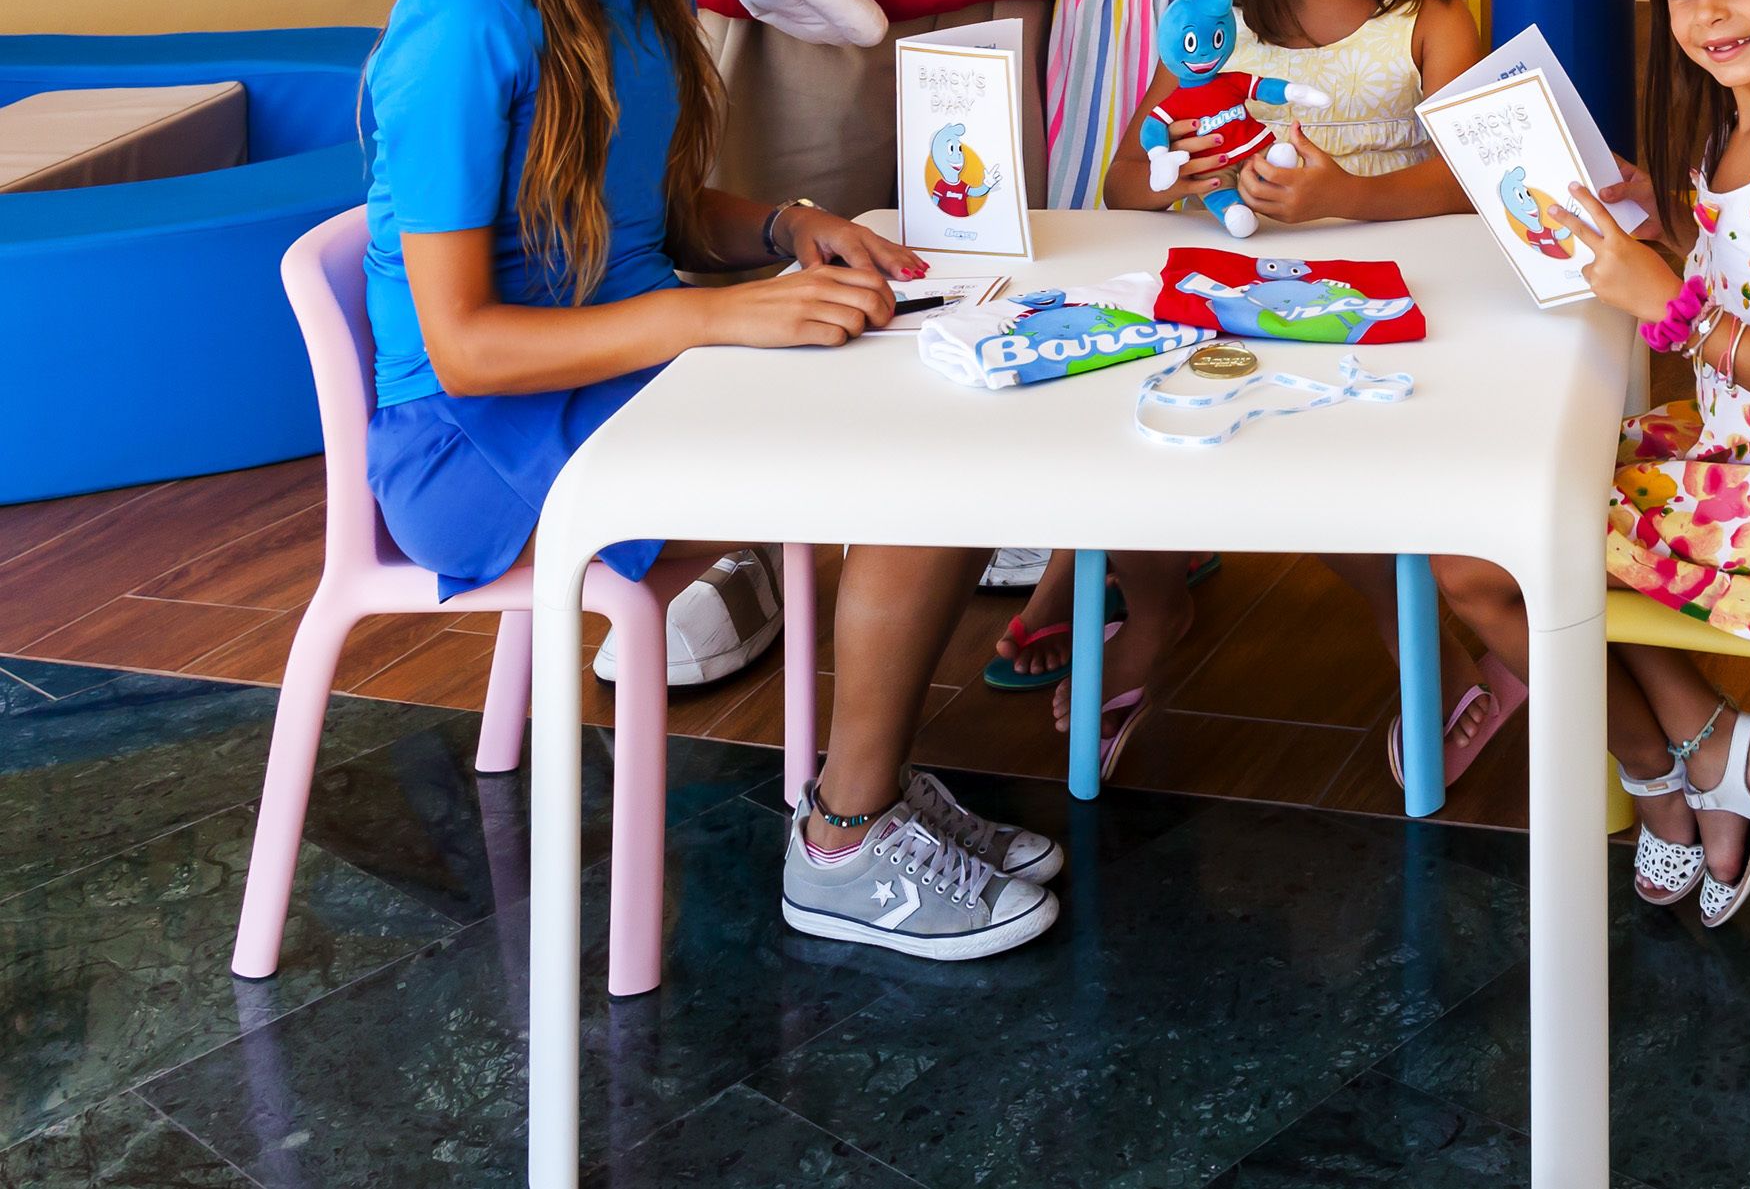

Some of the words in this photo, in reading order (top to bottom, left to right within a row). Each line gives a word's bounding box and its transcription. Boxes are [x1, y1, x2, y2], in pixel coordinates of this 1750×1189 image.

[919, 65, 986, 91] BARCY'S
[930, 94, 976, 113] DIARY
[1197, 103, 1246, 137] Barcy
[978, 320, 1202, 372] Barcy
